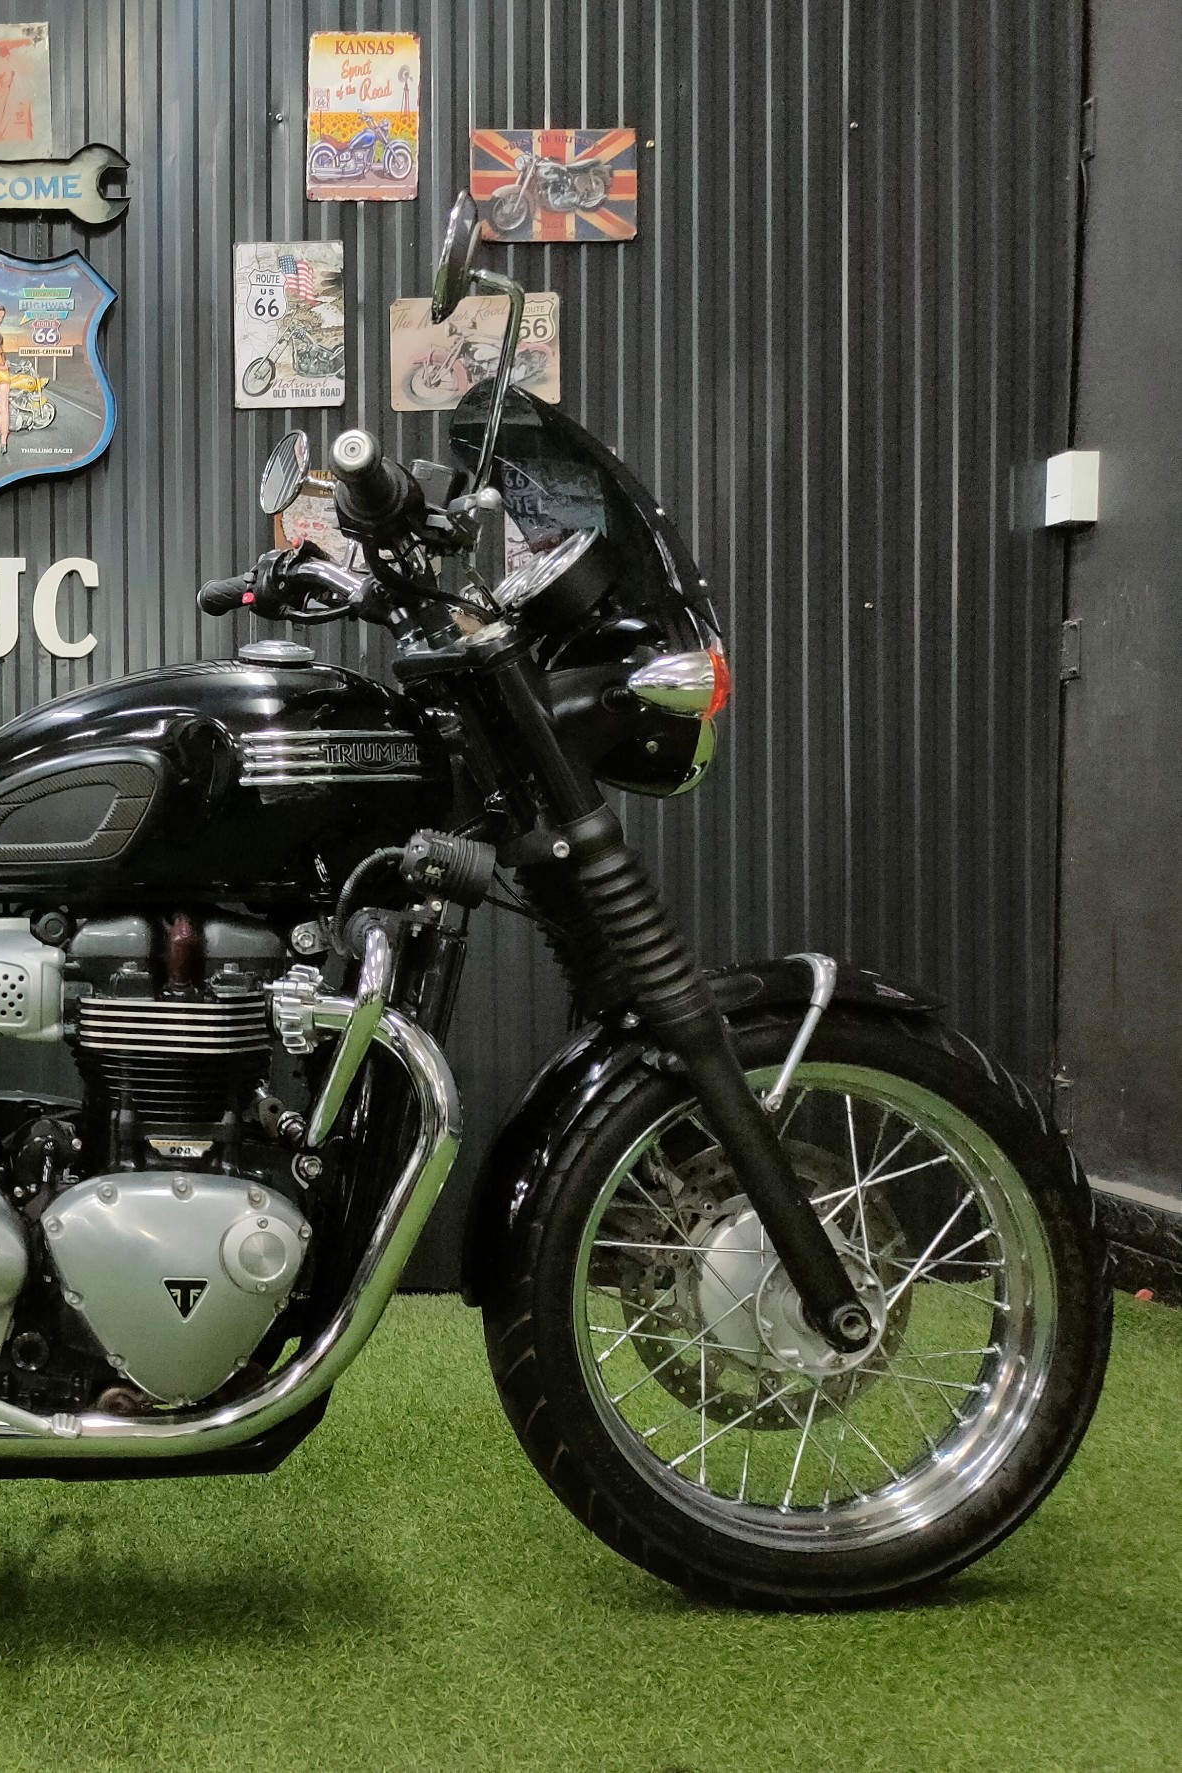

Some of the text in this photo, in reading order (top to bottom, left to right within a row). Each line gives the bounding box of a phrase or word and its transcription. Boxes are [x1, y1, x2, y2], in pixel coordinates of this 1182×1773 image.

[335, 40, 395, 55] KANSAS
[341, 59, 372, 83] Spirit
[359, 78, 392, 101] Road
[255, 273, 281, 284] ROUTE
[21, 300, 71, 310] HIGHWAY
[254, 297, 280, 318] 66
[476, 297, 510, 321] Road
[522, 305, 545, 314] OUTE
[36, 320, 55, 328] ROUTE
[519, 317, 548, 339] 66
[35, 328, 57, 343] 66
[271, 378, 328, 390] National
[272, 387, 341, 399] OLD TRAILS ROAD
[320, 743, 418, 765] TRIUMPH
